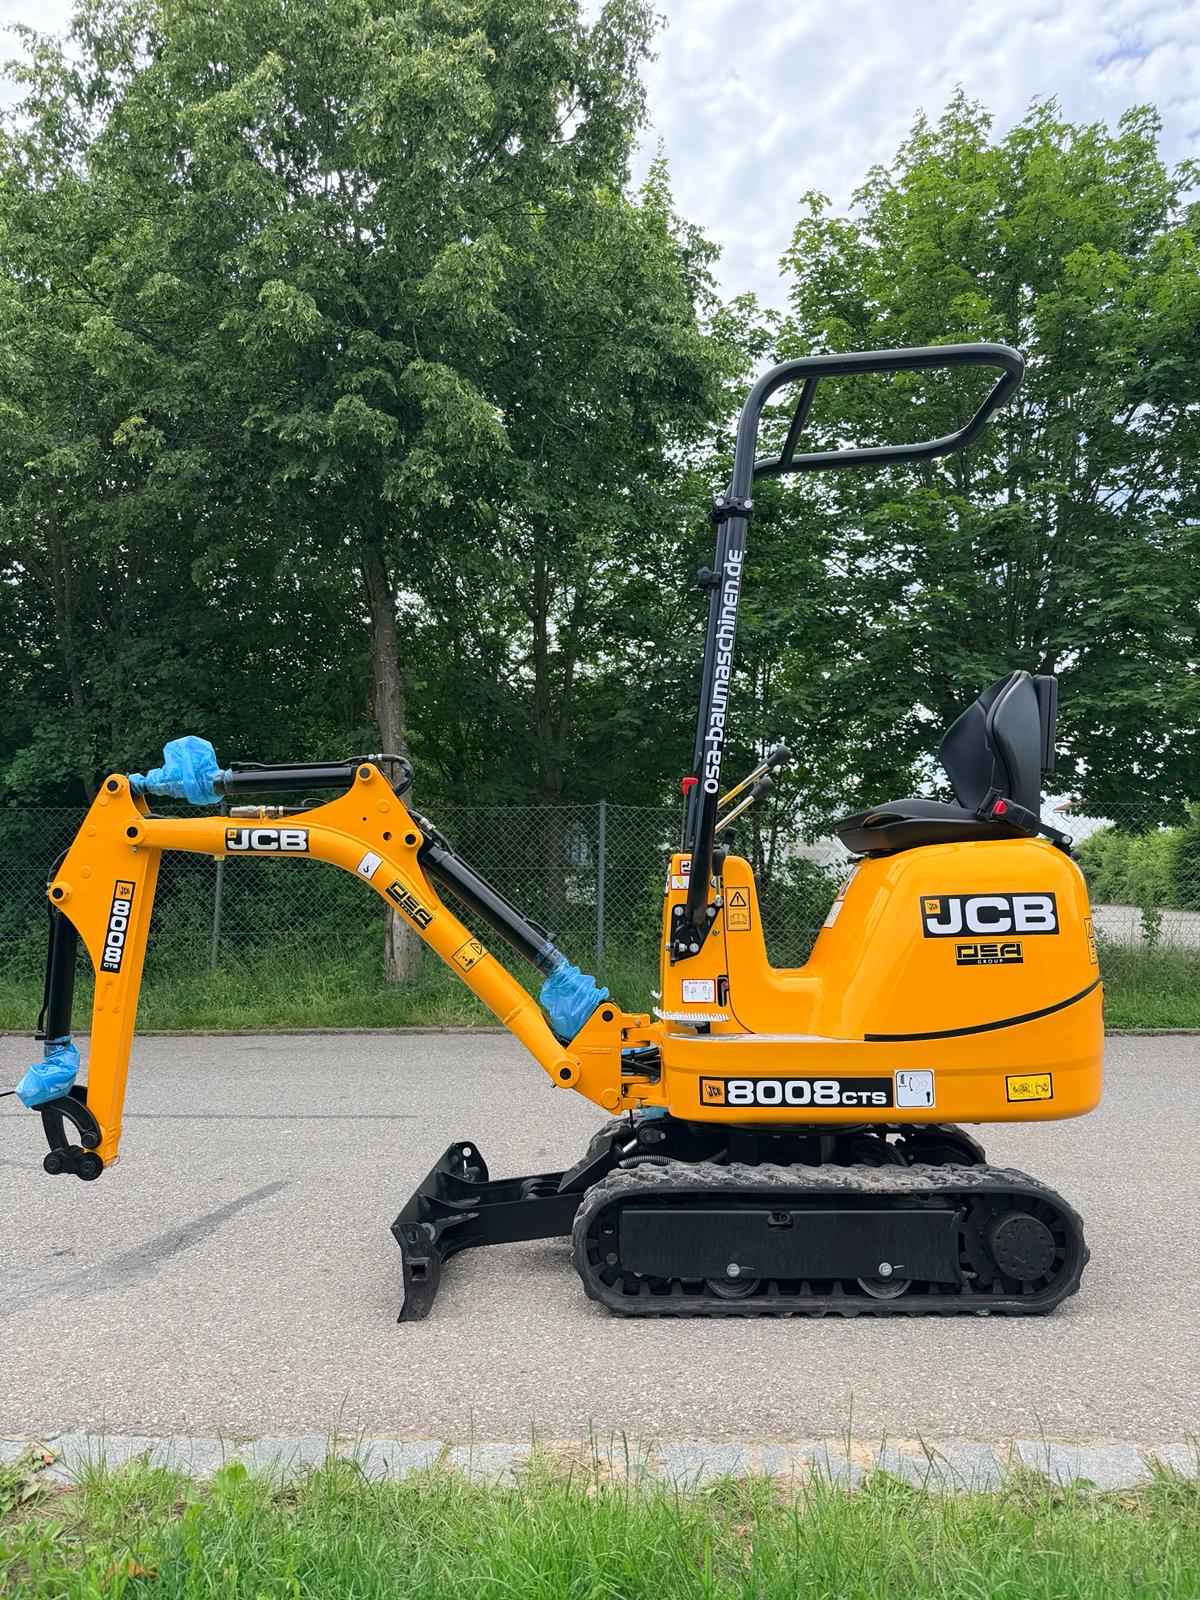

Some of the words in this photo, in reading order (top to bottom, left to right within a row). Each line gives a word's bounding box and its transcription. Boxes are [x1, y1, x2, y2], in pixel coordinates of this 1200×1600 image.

[704, 550, 743, 794] osa-baumaschinen.de
[227, 829, 307, 851] JCB
[104, 900, 131, 963] 8008
[926, 896, 1056, 934] JCB
